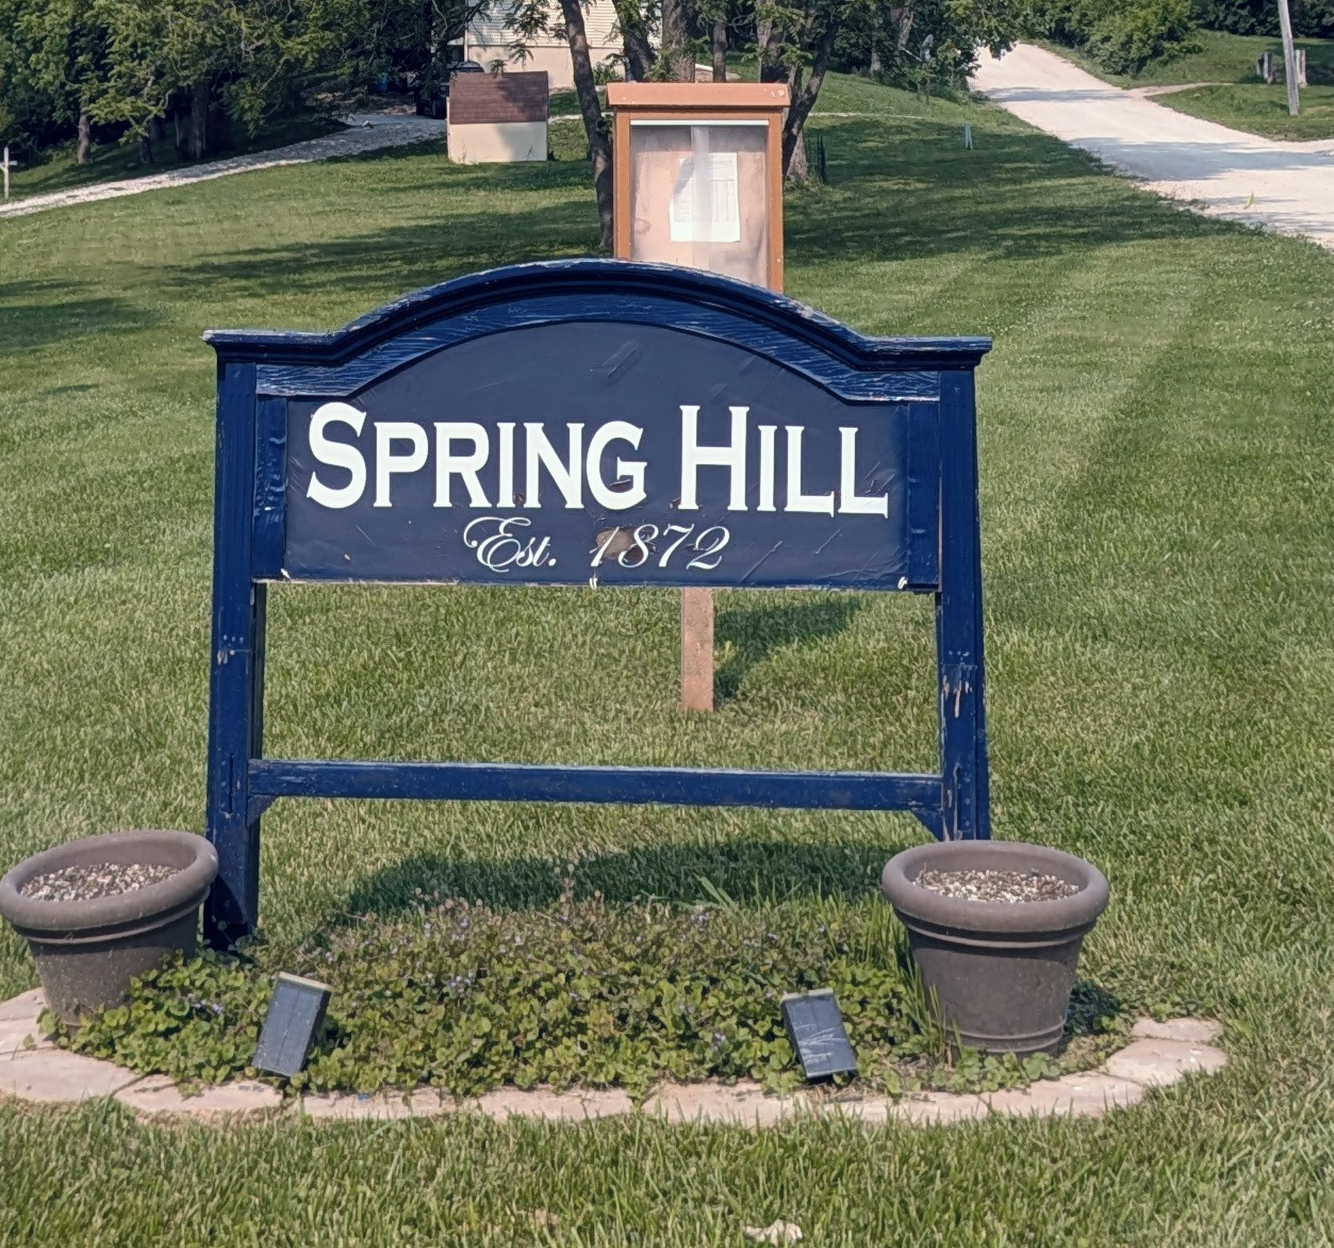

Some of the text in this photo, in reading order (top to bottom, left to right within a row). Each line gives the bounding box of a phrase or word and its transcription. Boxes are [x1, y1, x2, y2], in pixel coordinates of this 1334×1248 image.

[307, 401, 889, 519] SPRING HILL
[463, 516, 731, 573] Est. 1872
